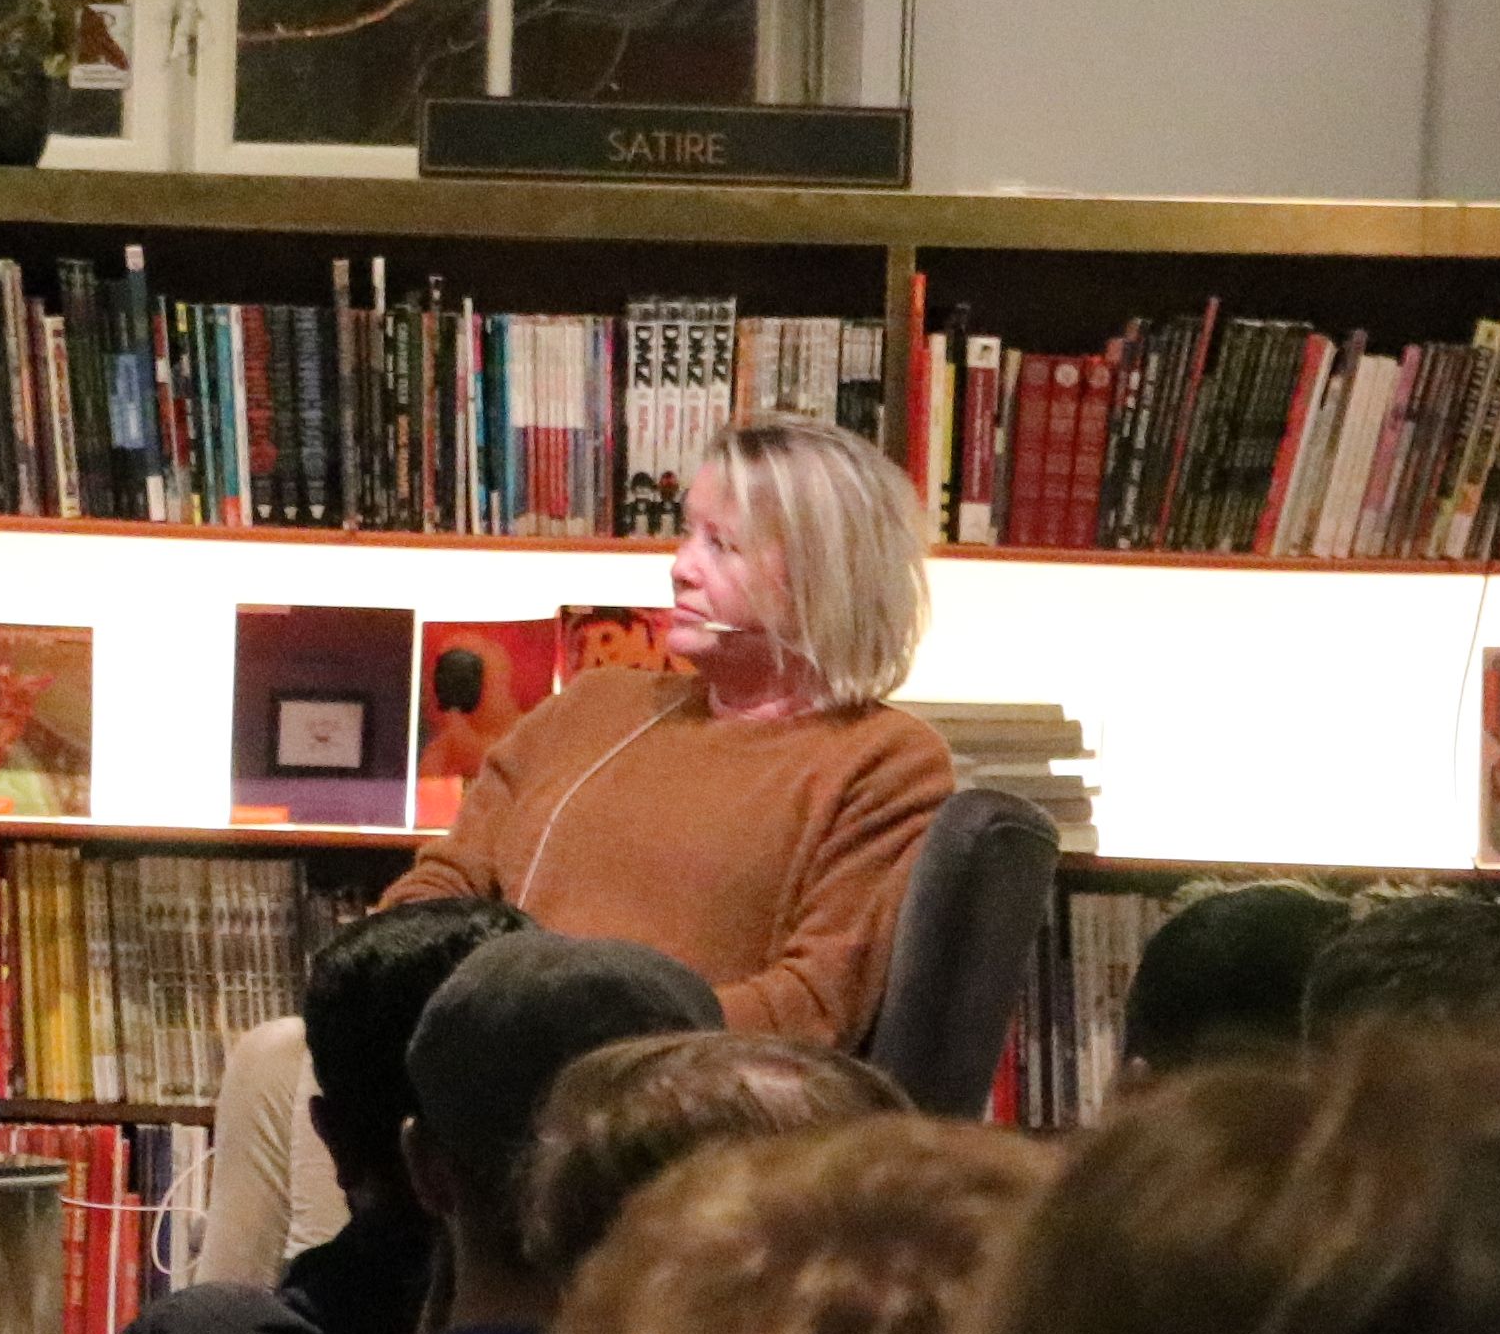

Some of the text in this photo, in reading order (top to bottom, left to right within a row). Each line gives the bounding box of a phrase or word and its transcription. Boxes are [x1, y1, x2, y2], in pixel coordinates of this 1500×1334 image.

[607, 129, 728, 165] SATIRE
[634, 324, 653, 389] DMZ
[661, 324, 681, 388] DMZ
[686, 324, 706, 389] DMZ
[711, 324, 732, 387] DMZ
